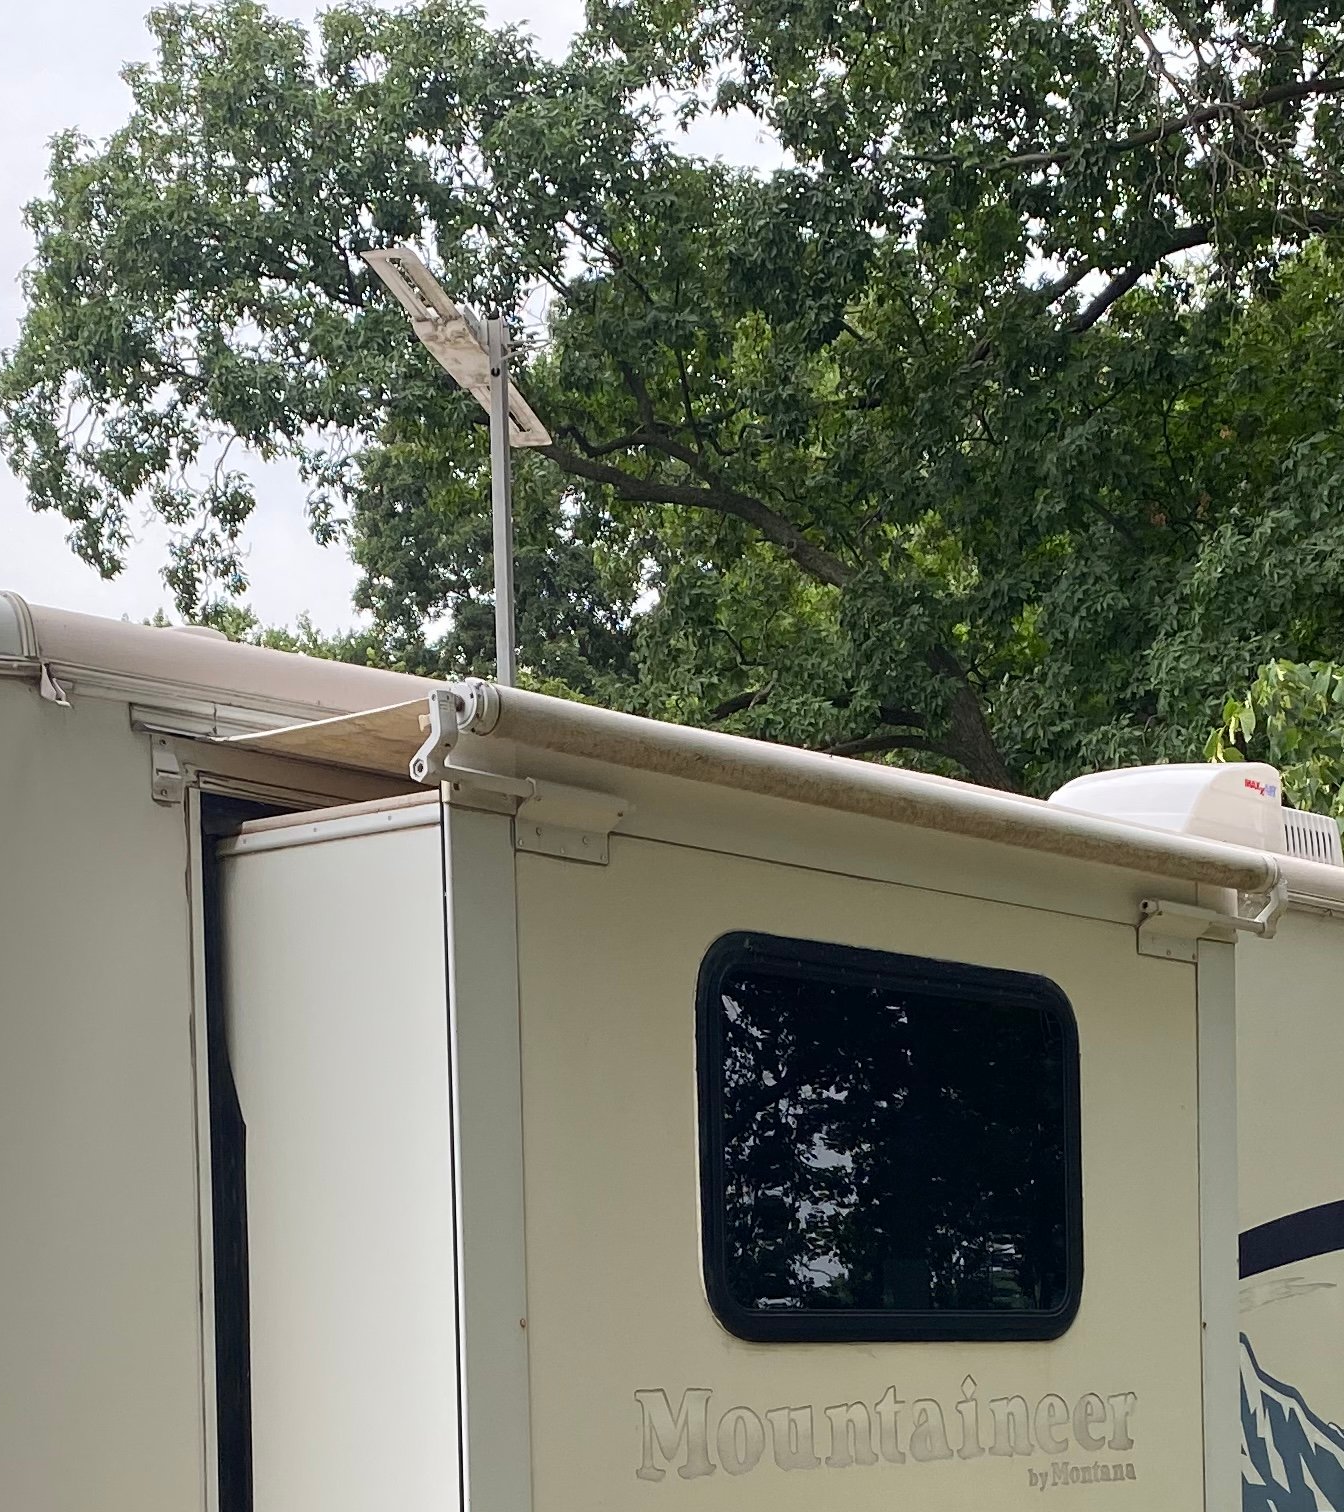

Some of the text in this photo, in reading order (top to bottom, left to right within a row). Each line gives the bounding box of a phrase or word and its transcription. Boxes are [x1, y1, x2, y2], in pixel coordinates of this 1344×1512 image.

[634, 1374, 1139, 1483] Mountaineer
[1027, 1461, 1137, 1492] by Montana
